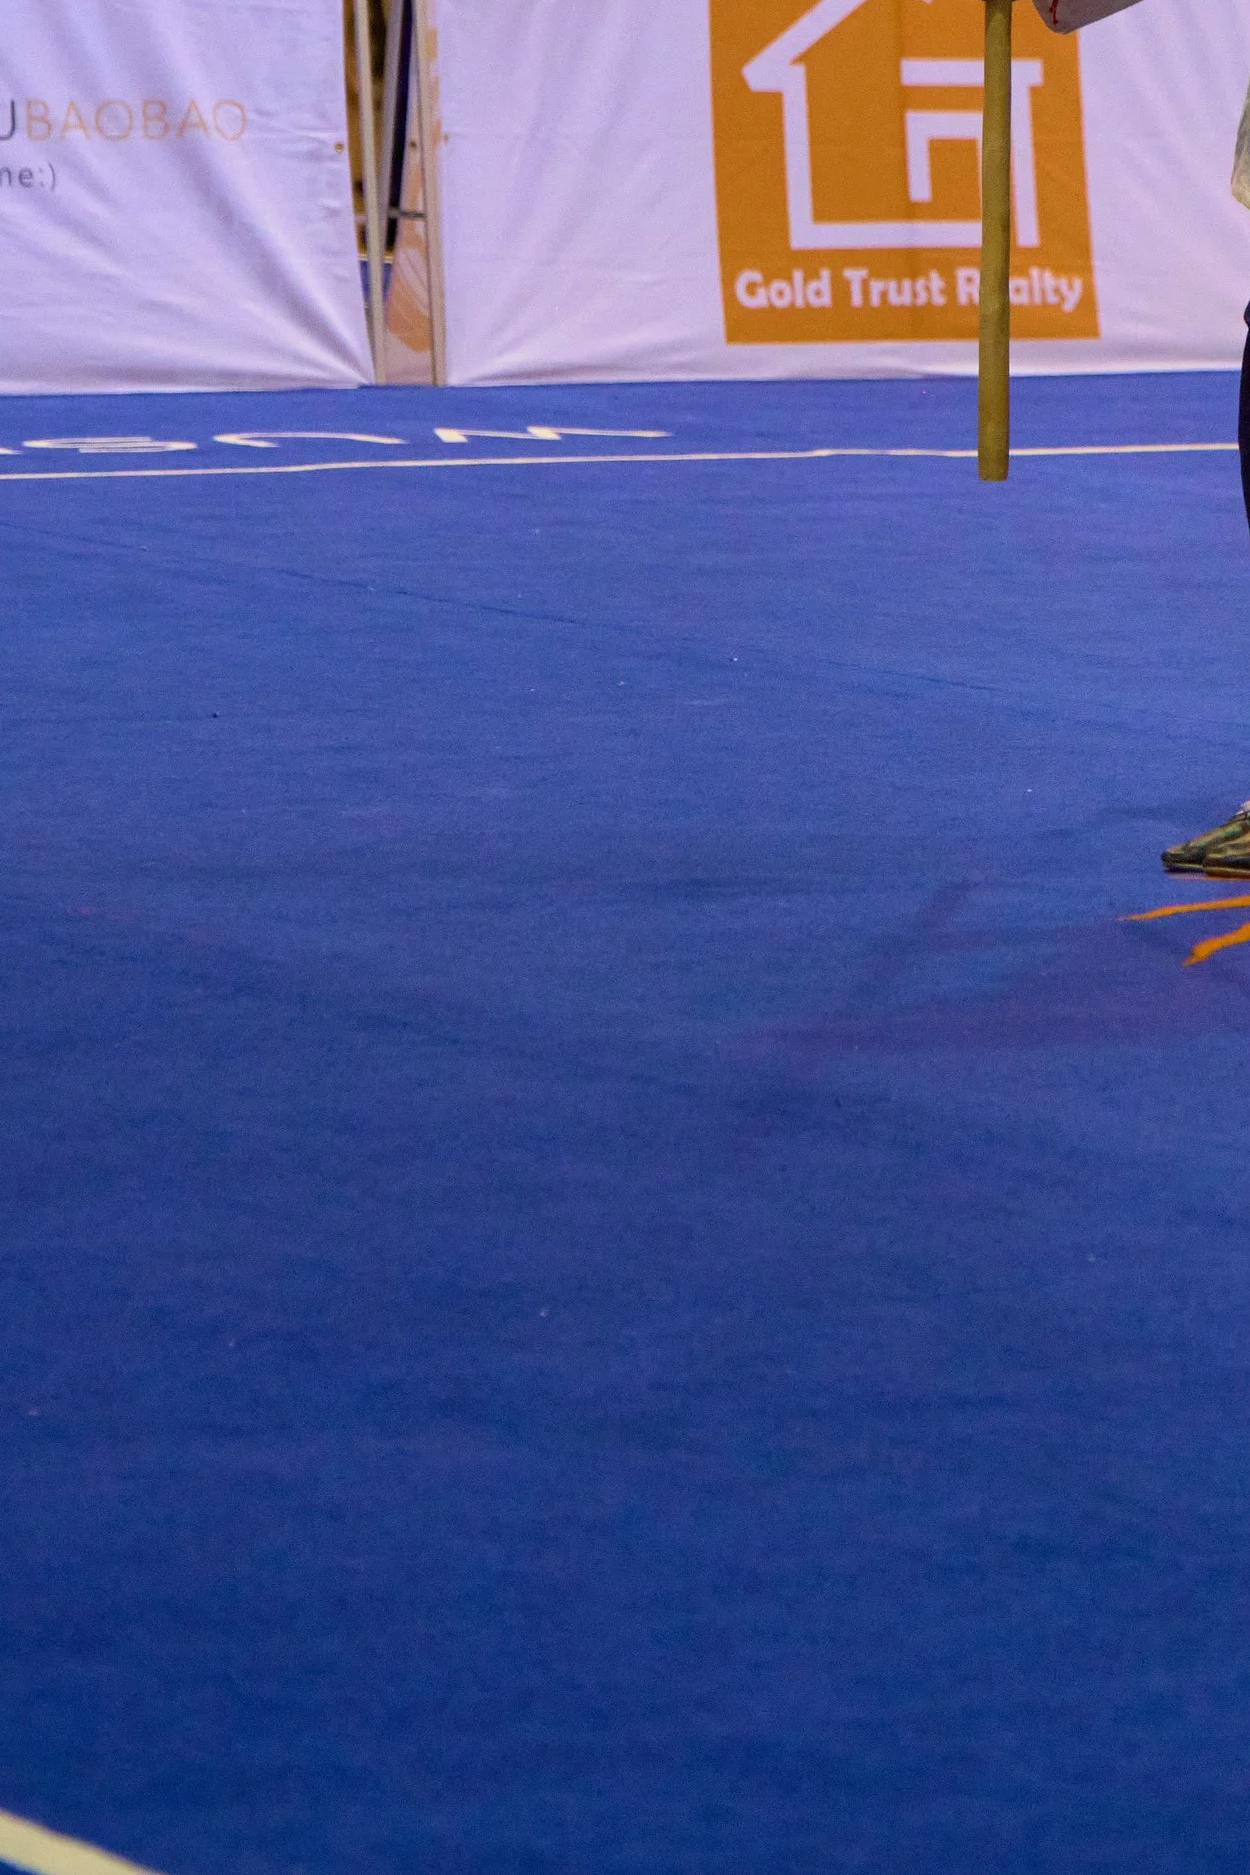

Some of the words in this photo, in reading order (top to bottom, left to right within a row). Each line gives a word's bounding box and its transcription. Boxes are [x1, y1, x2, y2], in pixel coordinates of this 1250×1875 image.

[734, 269, 832, 309] Gold
[843, 268, 947, 307] Trust
[956, 267, 1083, 313] Ralty
